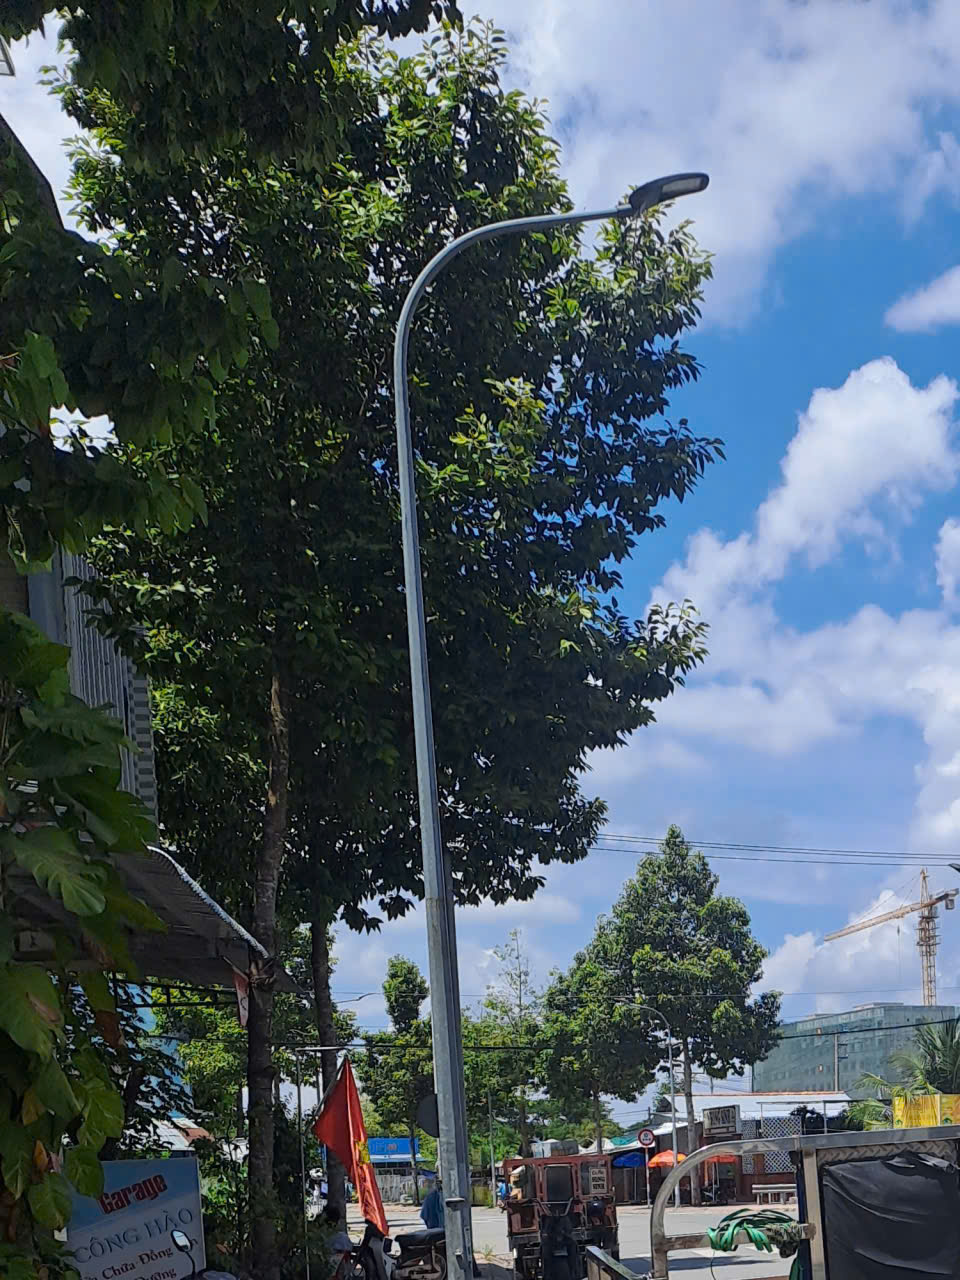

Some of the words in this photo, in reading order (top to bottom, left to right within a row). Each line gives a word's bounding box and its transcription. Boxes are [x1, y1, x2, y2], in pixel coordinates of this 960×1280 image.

[98, 1174, 168, 1214] Garage
[75, 1227, 140, 1263] CÔNG
[102, 1262, 136, 1280] Chữa
